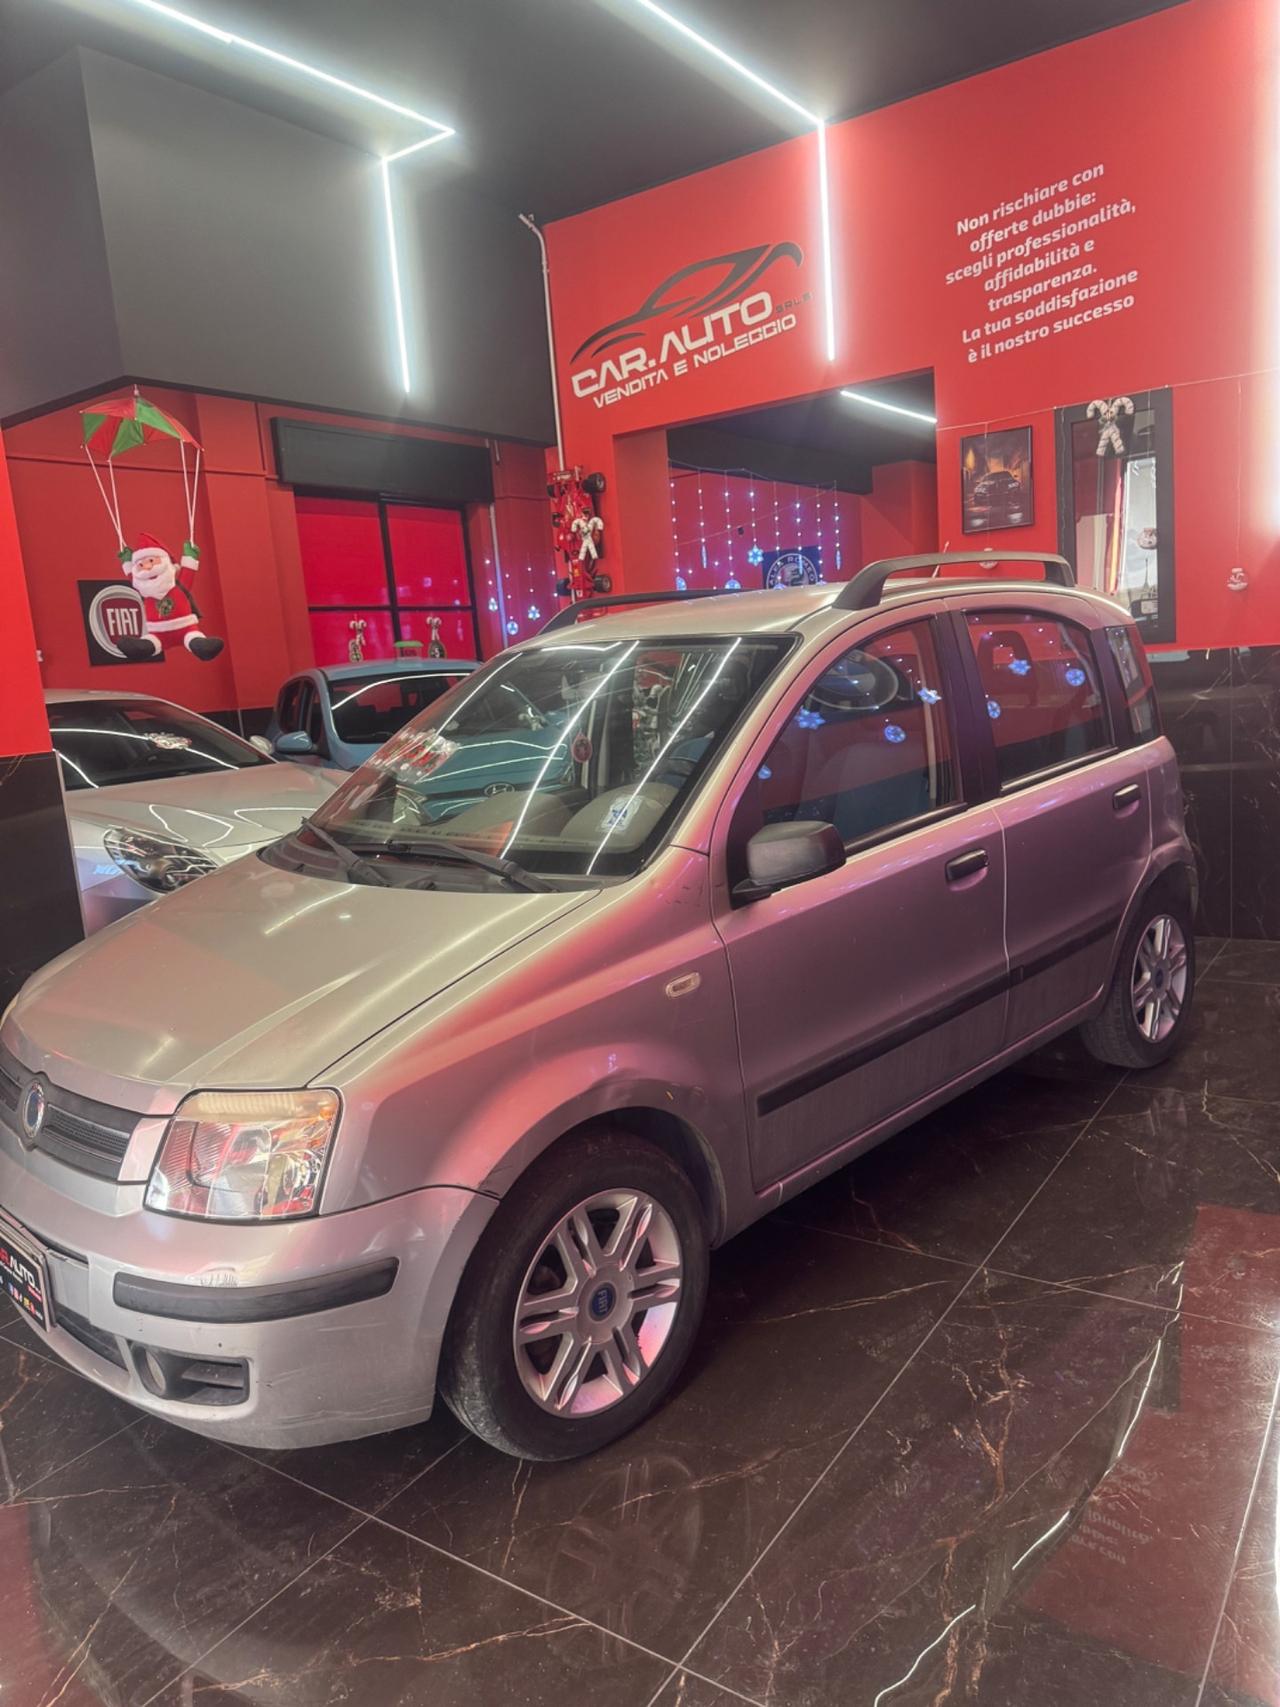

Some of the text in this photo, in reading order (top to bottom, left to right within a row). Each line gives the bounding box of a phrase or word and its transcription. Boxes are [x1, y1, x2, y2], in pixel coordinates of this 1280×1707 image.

[956, 164, 1105, 236] Non rischiare con
[969, 192, 1097, 253] offerte dubbie:
[945, 198, 1136, 285] scegli professionalità,
[983, 239, 1095, 292] affidabilità e
[962, 270, 1139, 344] La tua soddisfazione
[987, 263, 1097, 312] trasparenza.
[593, 313, 798, 409] VENDITA E NOLEGGIO
[967, 295, 1135, 364] è il nostro successo
[106, 608, 139, 636] FIAT
